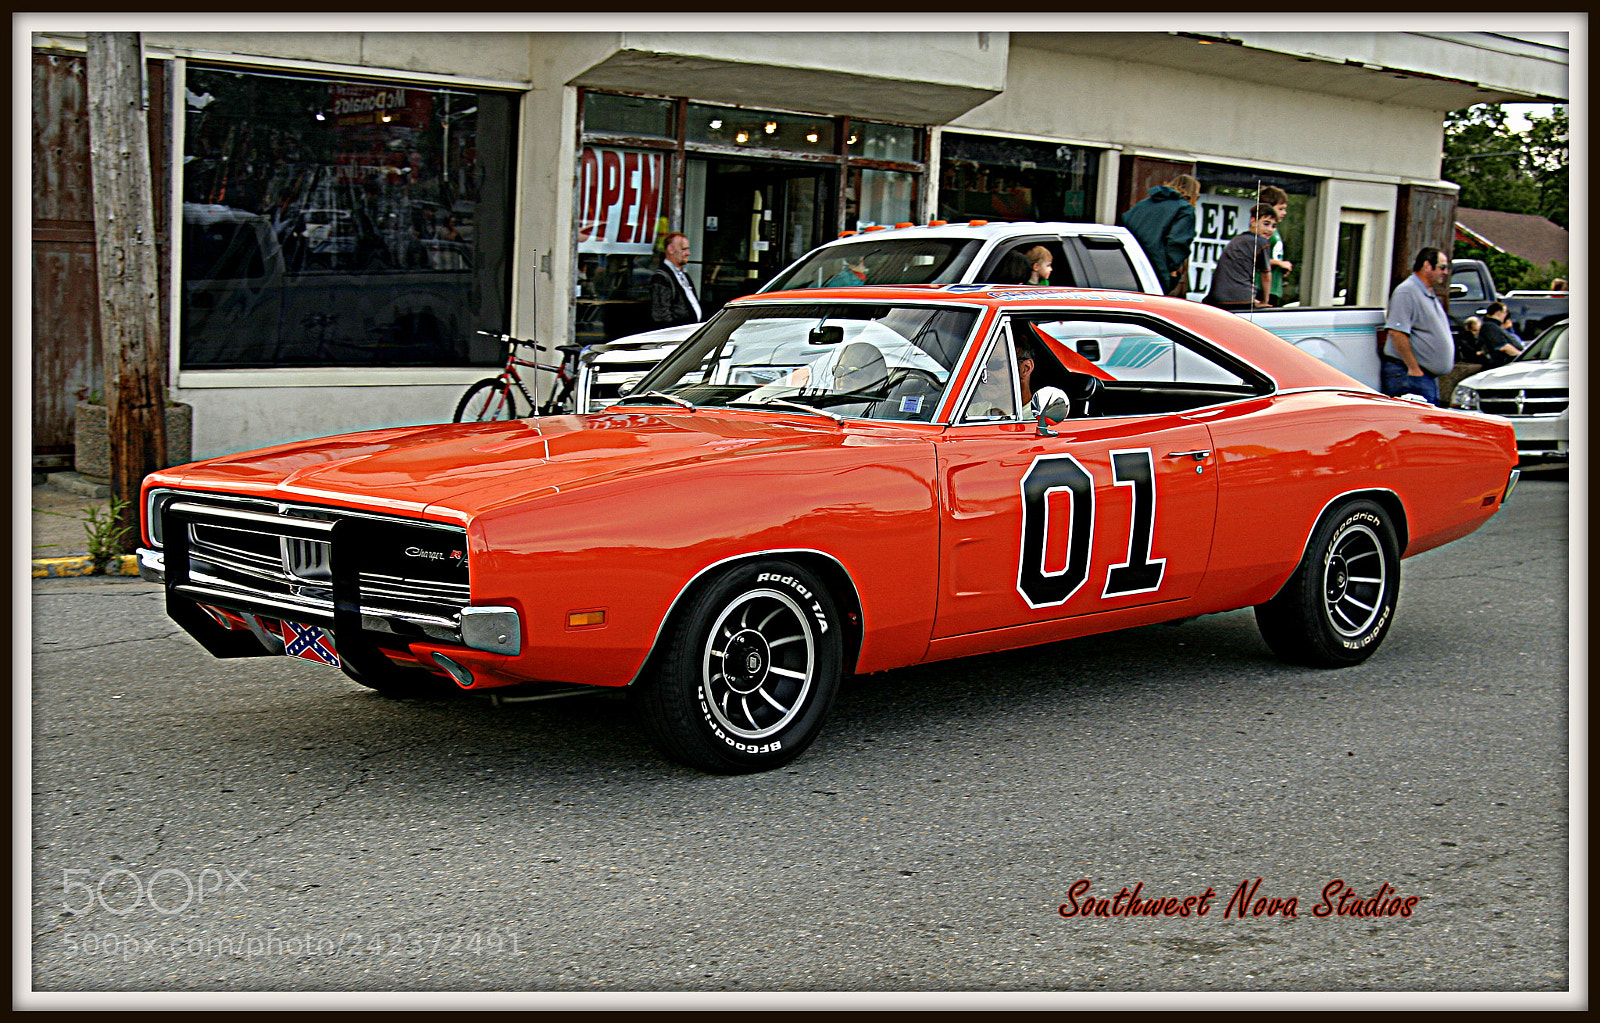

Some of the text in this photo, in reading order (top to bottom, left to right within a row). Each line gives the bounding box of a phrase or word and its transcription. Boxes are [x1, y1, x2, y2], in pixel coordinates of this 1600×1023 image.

[579, 147, 661, 244] OPEN
[405, 547, 469, 567] Charger R/
[1016, 447, 1167, 609] 01
[757, 573, 829, 634] Radial T/A
[697, 686, 782, 754] BFGoodrich
